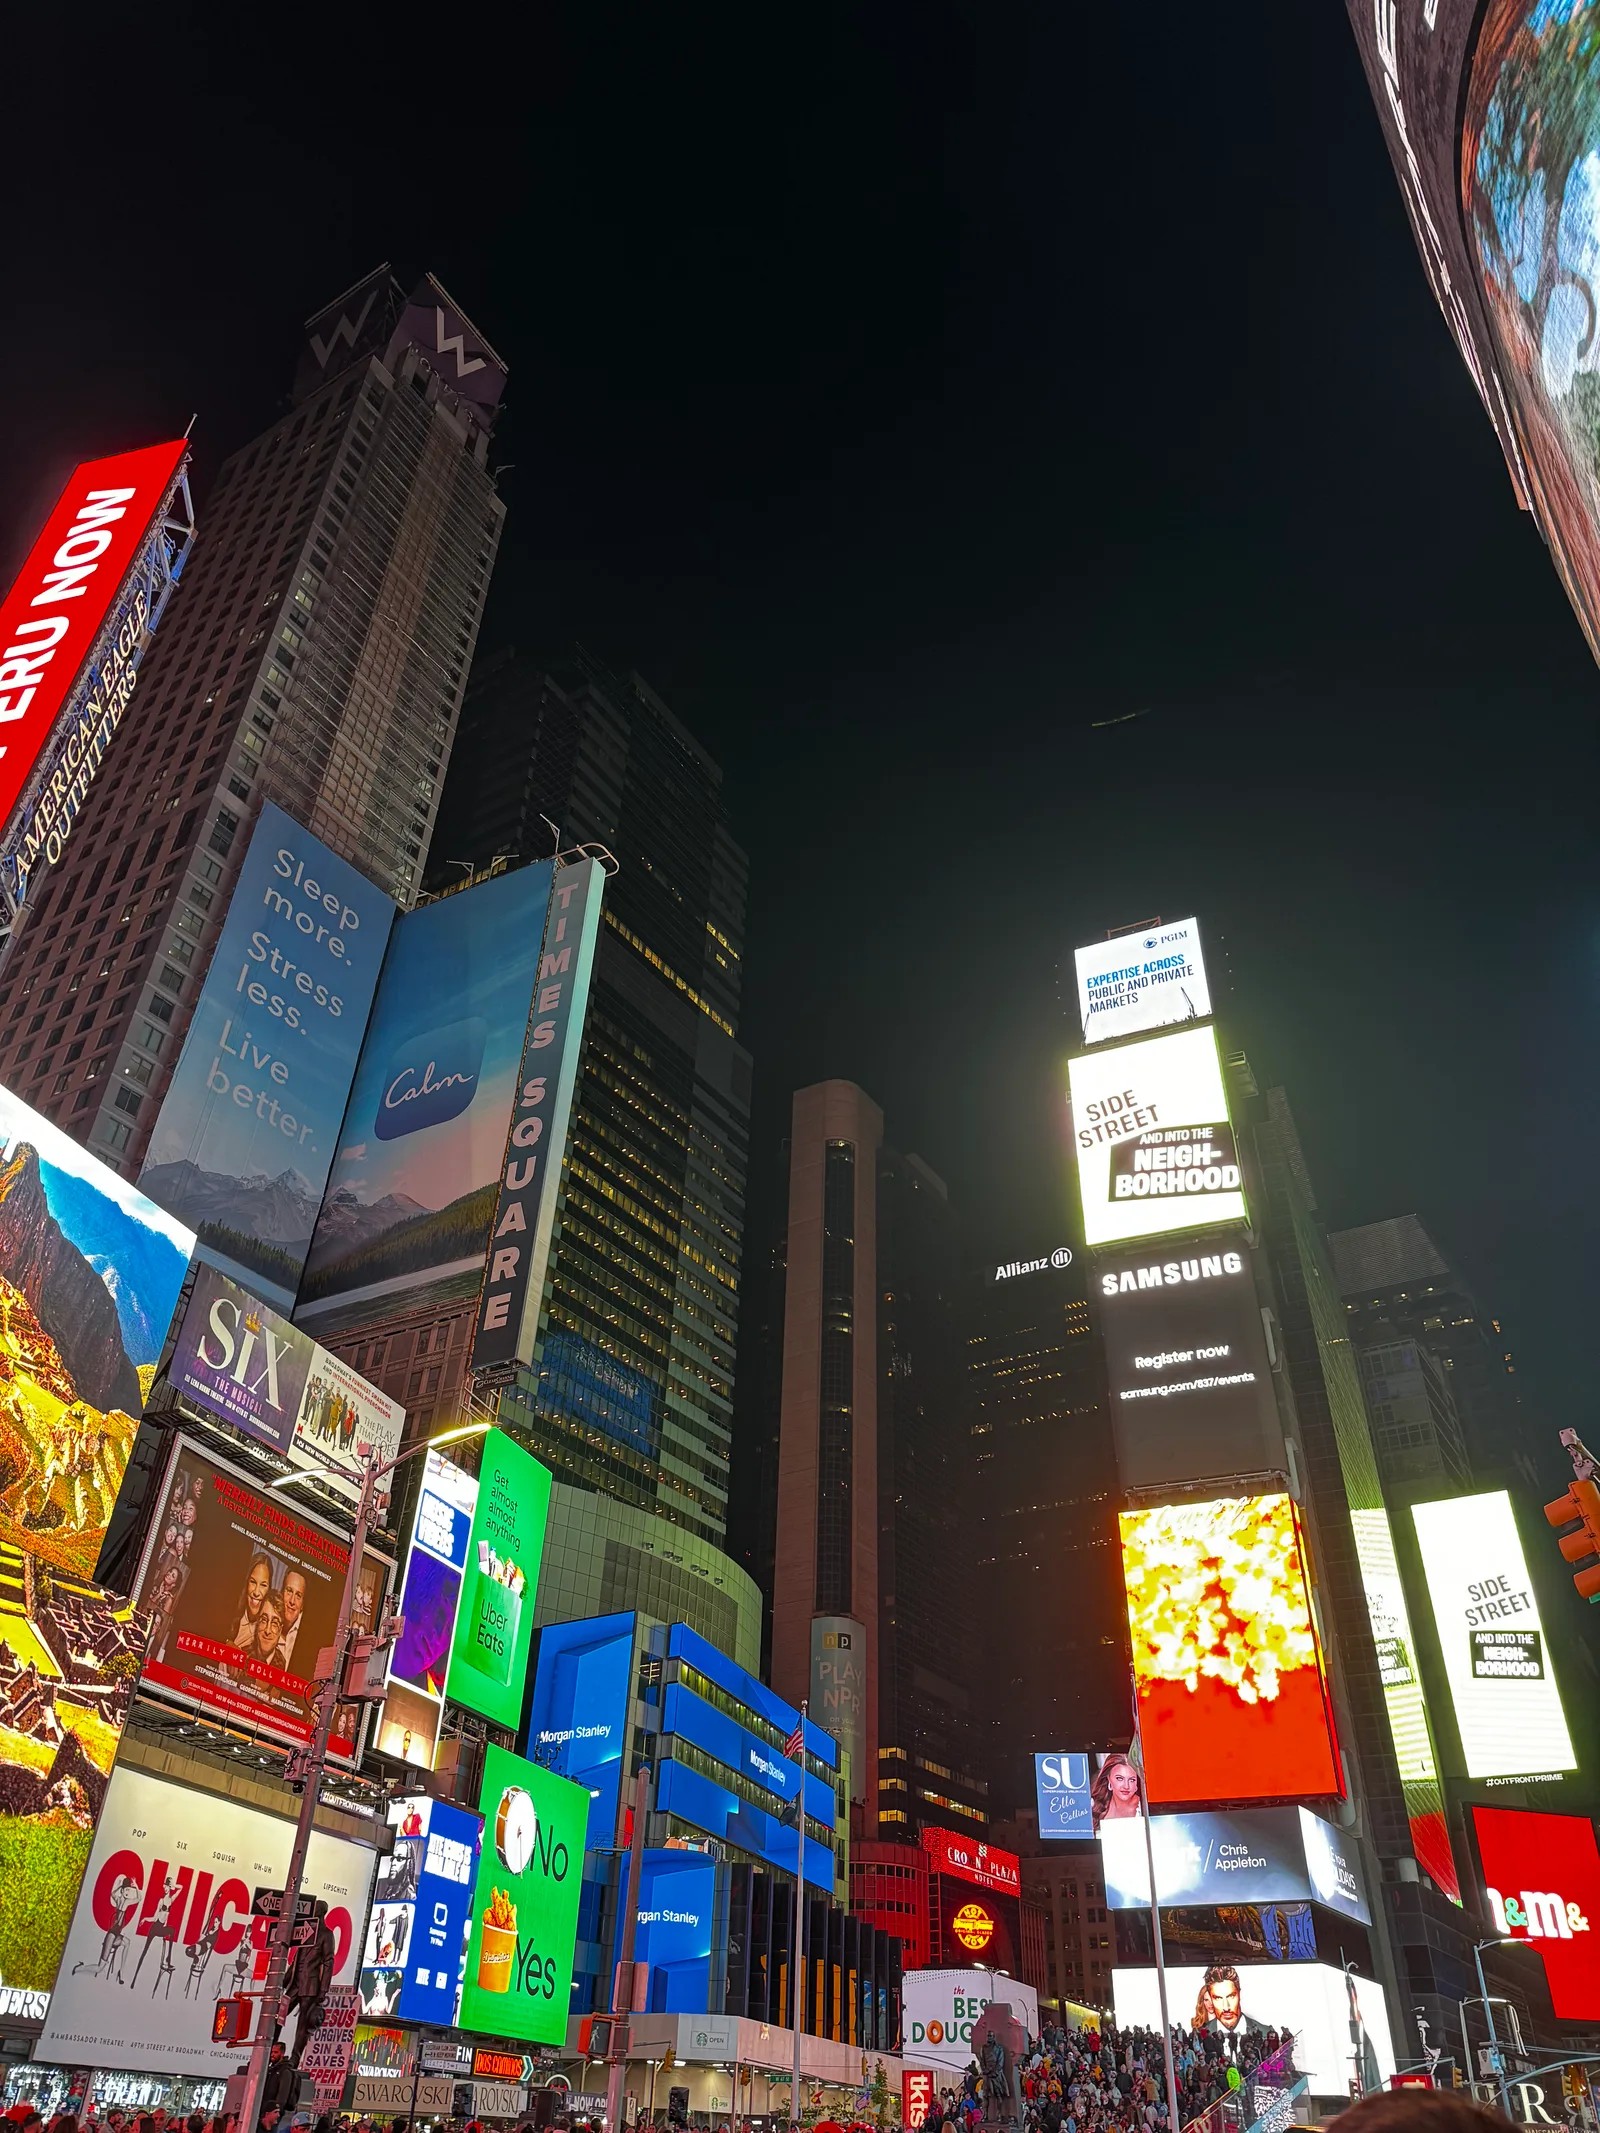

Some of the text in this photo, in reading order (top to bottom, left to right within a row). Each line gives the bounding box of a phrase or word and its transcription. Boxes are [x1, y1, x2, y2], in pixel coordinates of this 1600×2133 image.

[309, 289, 379, 369] W
[437, 305, 487, 378] W
[0, 488, 136, 758] ERU NOW
[16, 589, 148, 889] AMERICAN EAGLE
[46, 662, 138, 865] OUTFITTERS
[273, 849, 361, 931] Sleep
[263, 887, 353, 967] more.
[1160, 930, 1188, 944] PGIM
[247, 930, 344, 1018] Stress
[1087, 954, 1185, 989] EXPERTISE ACROSS
[1088, 964, 1194, 1001] PUBLIC AND PRIVATE
[236, 964, 308, 1035] less.
[1089, 992, 1139, 1014] MARKETS
[219, 1020, 290, 1085] Live
[385, 1061, 474, 1110] Calm
[206, 1057, 319, 1153] better.
[483, 883, 579, 1331] TIMES SQUARE
[1086, 1089, 1138, 1122] SIDE
[1078, 1104, 1160, 1149] STREET
[1139, 1126, 1214, 1145] AND INTO THE
[1133, 1143, 1222, 1172] NEIGH-
[1115, 1165, 1240, 1198] BORHOOD
[994, 1256, 1049, 1281] Allianz
[1102, 1252, 1243, 1296] SAMSUNG
[196, 1298, 293, 1411] SIX
[1135, 1344, 1230, 1370] Register now
[214, 1376, 263, 1415] THE MUSICAL
[322, 1365, 333, 1376] AND
[332, 1372, 364, 1400] INTERNATIONAL
[1120, 1371, 1256, 1401] samsung.com/837/events
[358, 1425, 375, 1441] THAT
[373, 1436, 396, 1459] GOES
[364, 1416, 396, 1442] THE PLAY
[493, 1468, 509, 1489] Get
[491, 1486, 518, 1514] almost
[217, 1496, 223, 1505] A
[223, 1498, 267, 1528] REVELATORY
[265, 1522, 280, 1535] AND
[279, 1528, 323, 1561] INTOXICATING
[231, 1522, 246, 1535] DANIEL
[263, 1504, 297, 1533] FINDS
[488, 1501, 516, 1529] almost
[485, 1516, 521, 1553] anything
[1467, 1575, 1512, 1602] SIDE
[480, 1598, 508, 1631] Uber
[1464, 1592, 1532, 1627] STREET
[476, 1624, 505, 1657] Eats
[1475, 1633, 1535, 1644] AND INTO THE
[178, 1635, 226, 1656] MERRILY
[232, 1652, 245, 1663] WE
[250, 1663, 273, 1679] ROLL
[1475, 1661, 1540, 1676] BORHOOD
[194, 1664, 216, 1678] STEPHEN
[540, 1723, 612, 1744] Morgan Stanley
[750, 1748, 787, 1788] Morgan Stanley
[1042, 1757, 1087, 1789] SU
[1486, 1773, 1563, 1787] #OUTFRONTPRIME
[322, 1791, 375, 1817] #OUTFRONTPRIME
[1050, 1795, 1076, 1813] Ella
[1060, 1808, 1088, 1824] Collins
[131, 1828, 147, 1839] POP
[176, 1840, 188, 1851] SIX
[212, 1851, 236, 1864] SQUISH
[529, 1819, 570, 1882] No
[1215, 1856, 1267, 1872] Appleton
[1219, 1844, 1248, 1857] Chris
[990, 1861, 1018, 1882] PLAZA
[323, 1882, 348, 1896] LIPSCHITZ
[262, 1897, 281, 1909] ONE
[964, 1908, 982, 1918] HOT
[637, 1908, 700, 1927] rgan Stanley
[295, 1928, 310, 1939] WAY
[965, 1935, 984, 1946] NOW
[515, 1937, 557, 2000] Yes
[953, 1986, 965, 1995] the
[321, 2009, 357, 2028] ESUS
[953, 1998, 992, 2019] BES
[56, 2033, 205, 2056] AMBASSADOR THEATRE 49TH STREET AT BROADWAY
[313, 2029, 354, 2042] ORGIVES
[306, 2056, 345, 2067] SAVES
[313, 2044, 343, 2055] SIN &
[309, 2069, 346, 2084] EPENT
[358, 2065, 402, 2078] SWAROVSKI
[477, 2053, 492, 2072] DOS
[491, 2055, 523, 2077] CAMINOS
[104, 2077, 163, 2106] GRAND
[356, 2083, 451, 2105] SWAROVSKI
[574, 2095, 594, 2112] NOW
[910, 2074, 930, 2128] tkts
[1516, 2083, 1562, 2125] R
